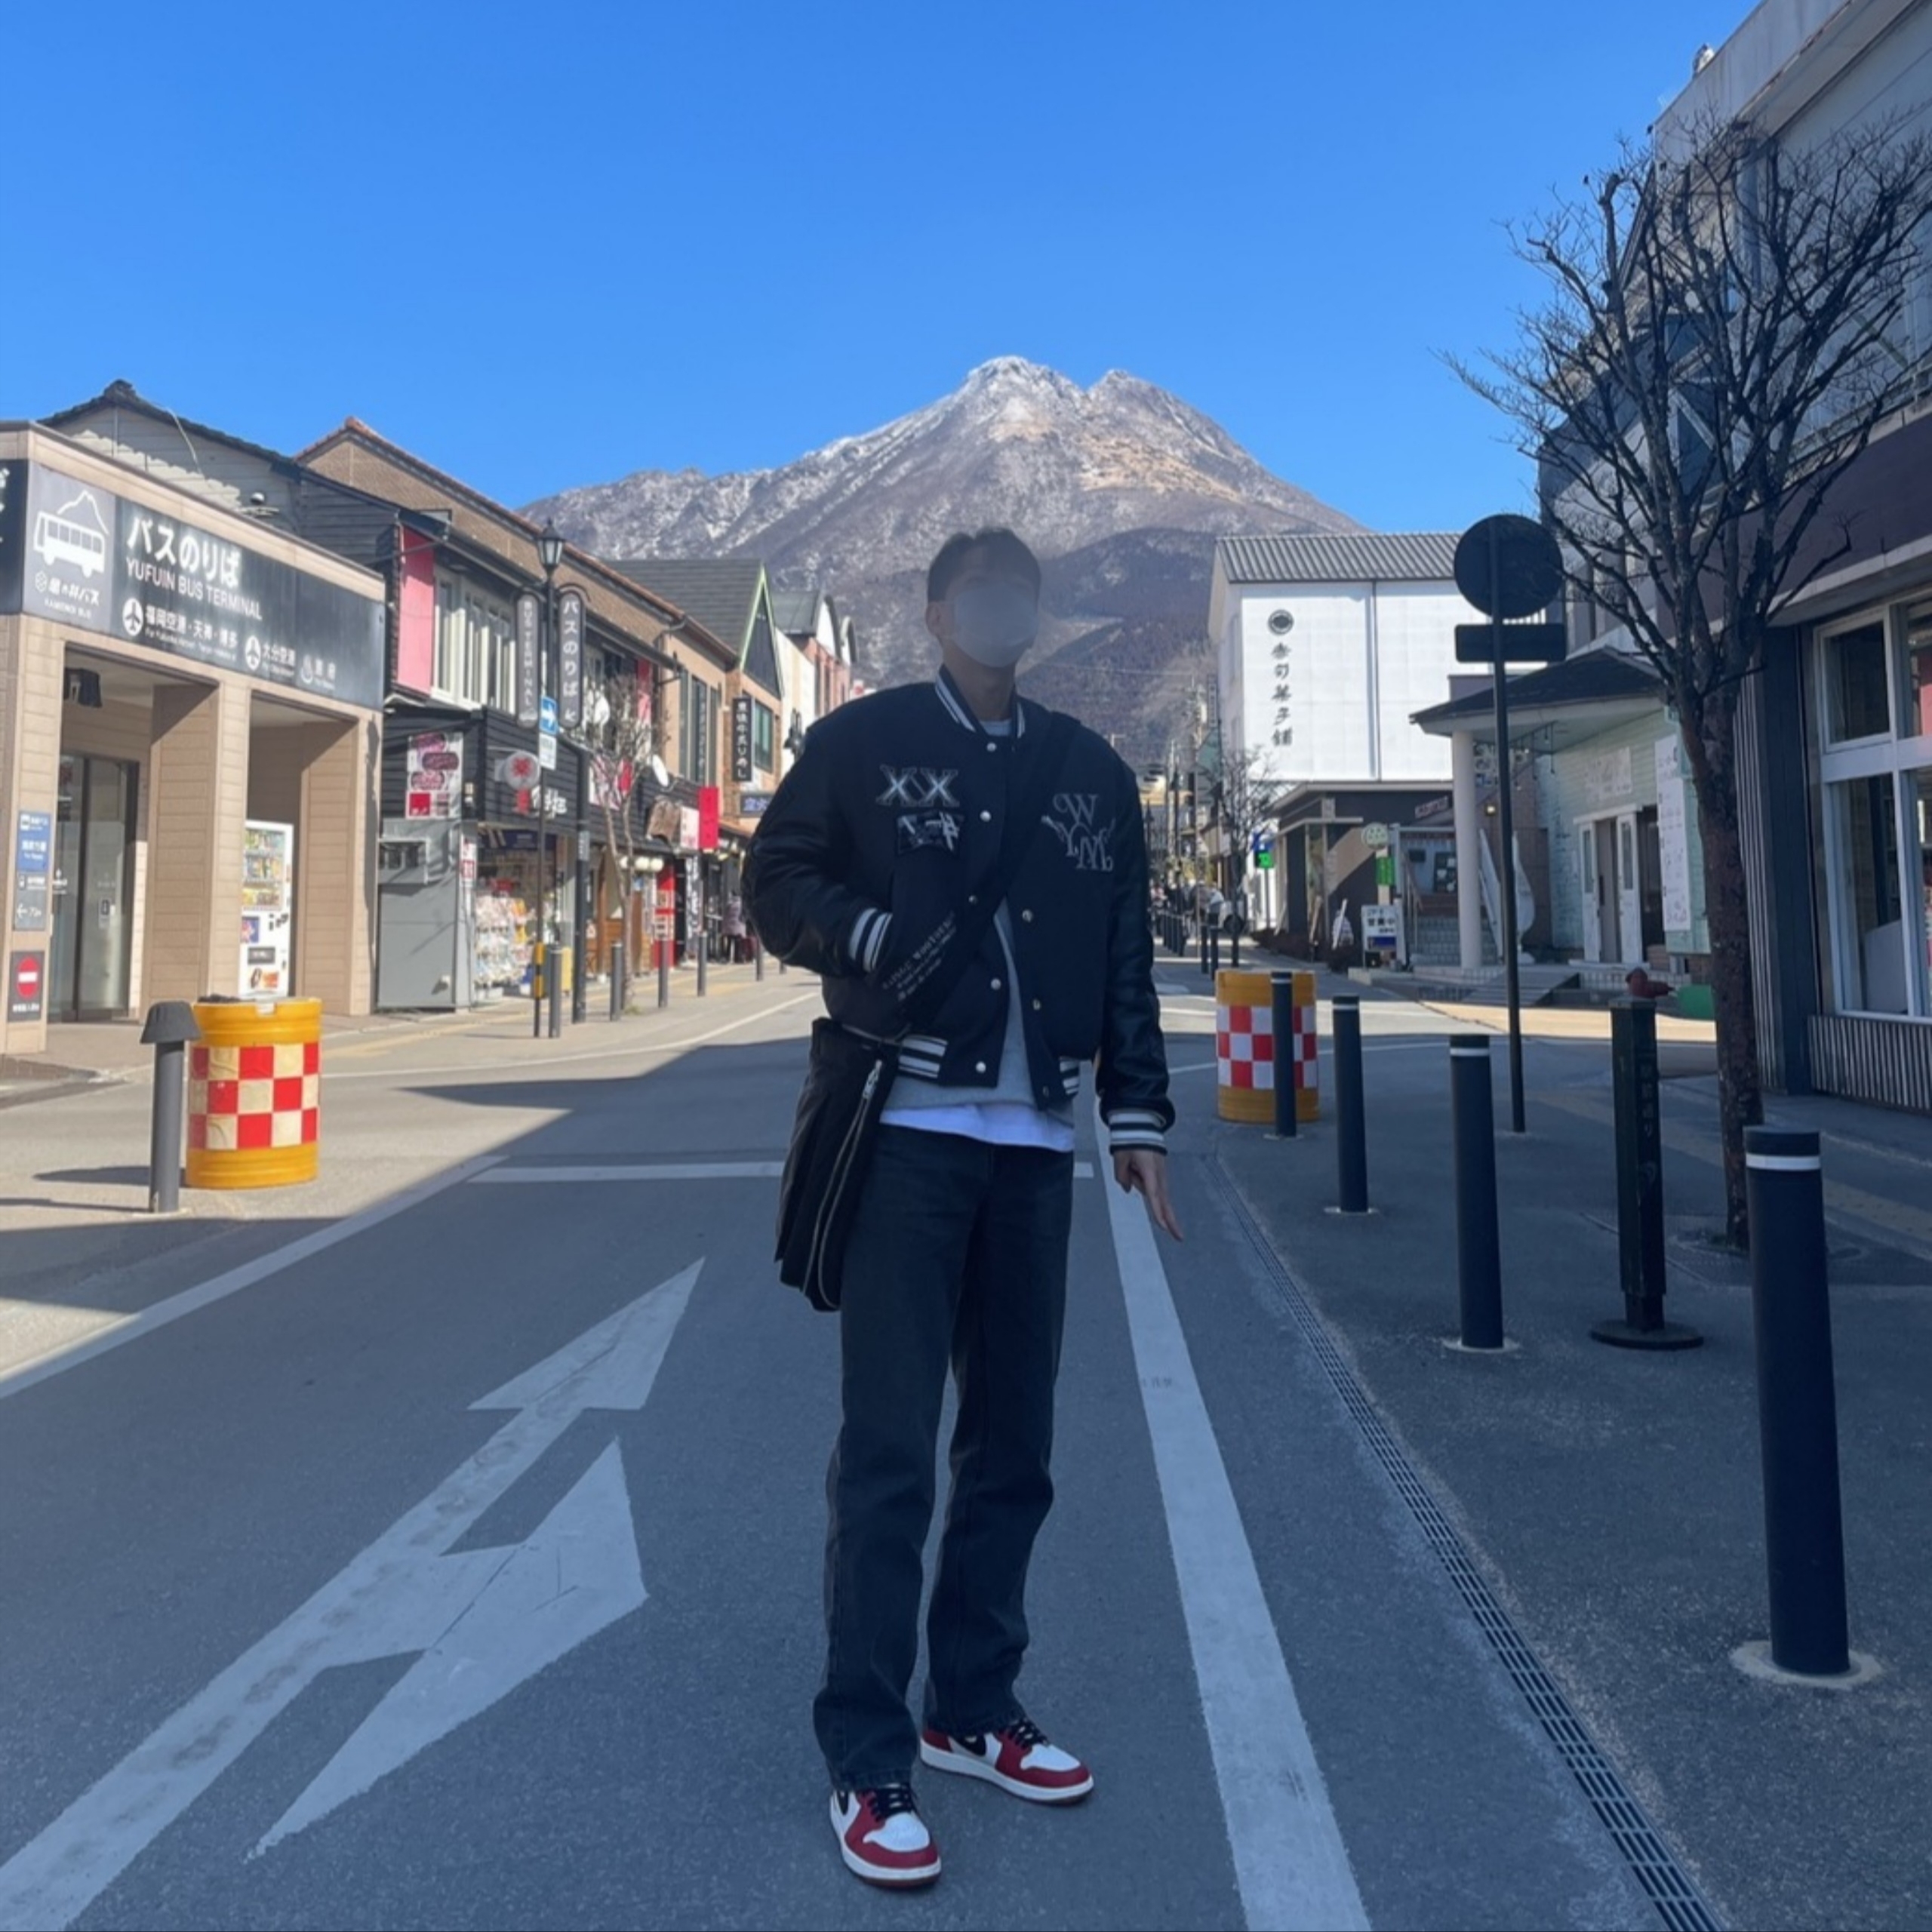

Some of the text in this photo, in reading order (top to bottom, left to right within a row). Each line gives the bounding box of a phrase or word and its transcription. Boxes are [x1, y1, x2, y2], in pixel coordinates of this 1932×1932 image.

[126, 556, 263, 622] YUFUIN BUS TERMINAL
[127, 516, 242, 589] バスのりば
[562, 601, 580, 698] バスのりば
